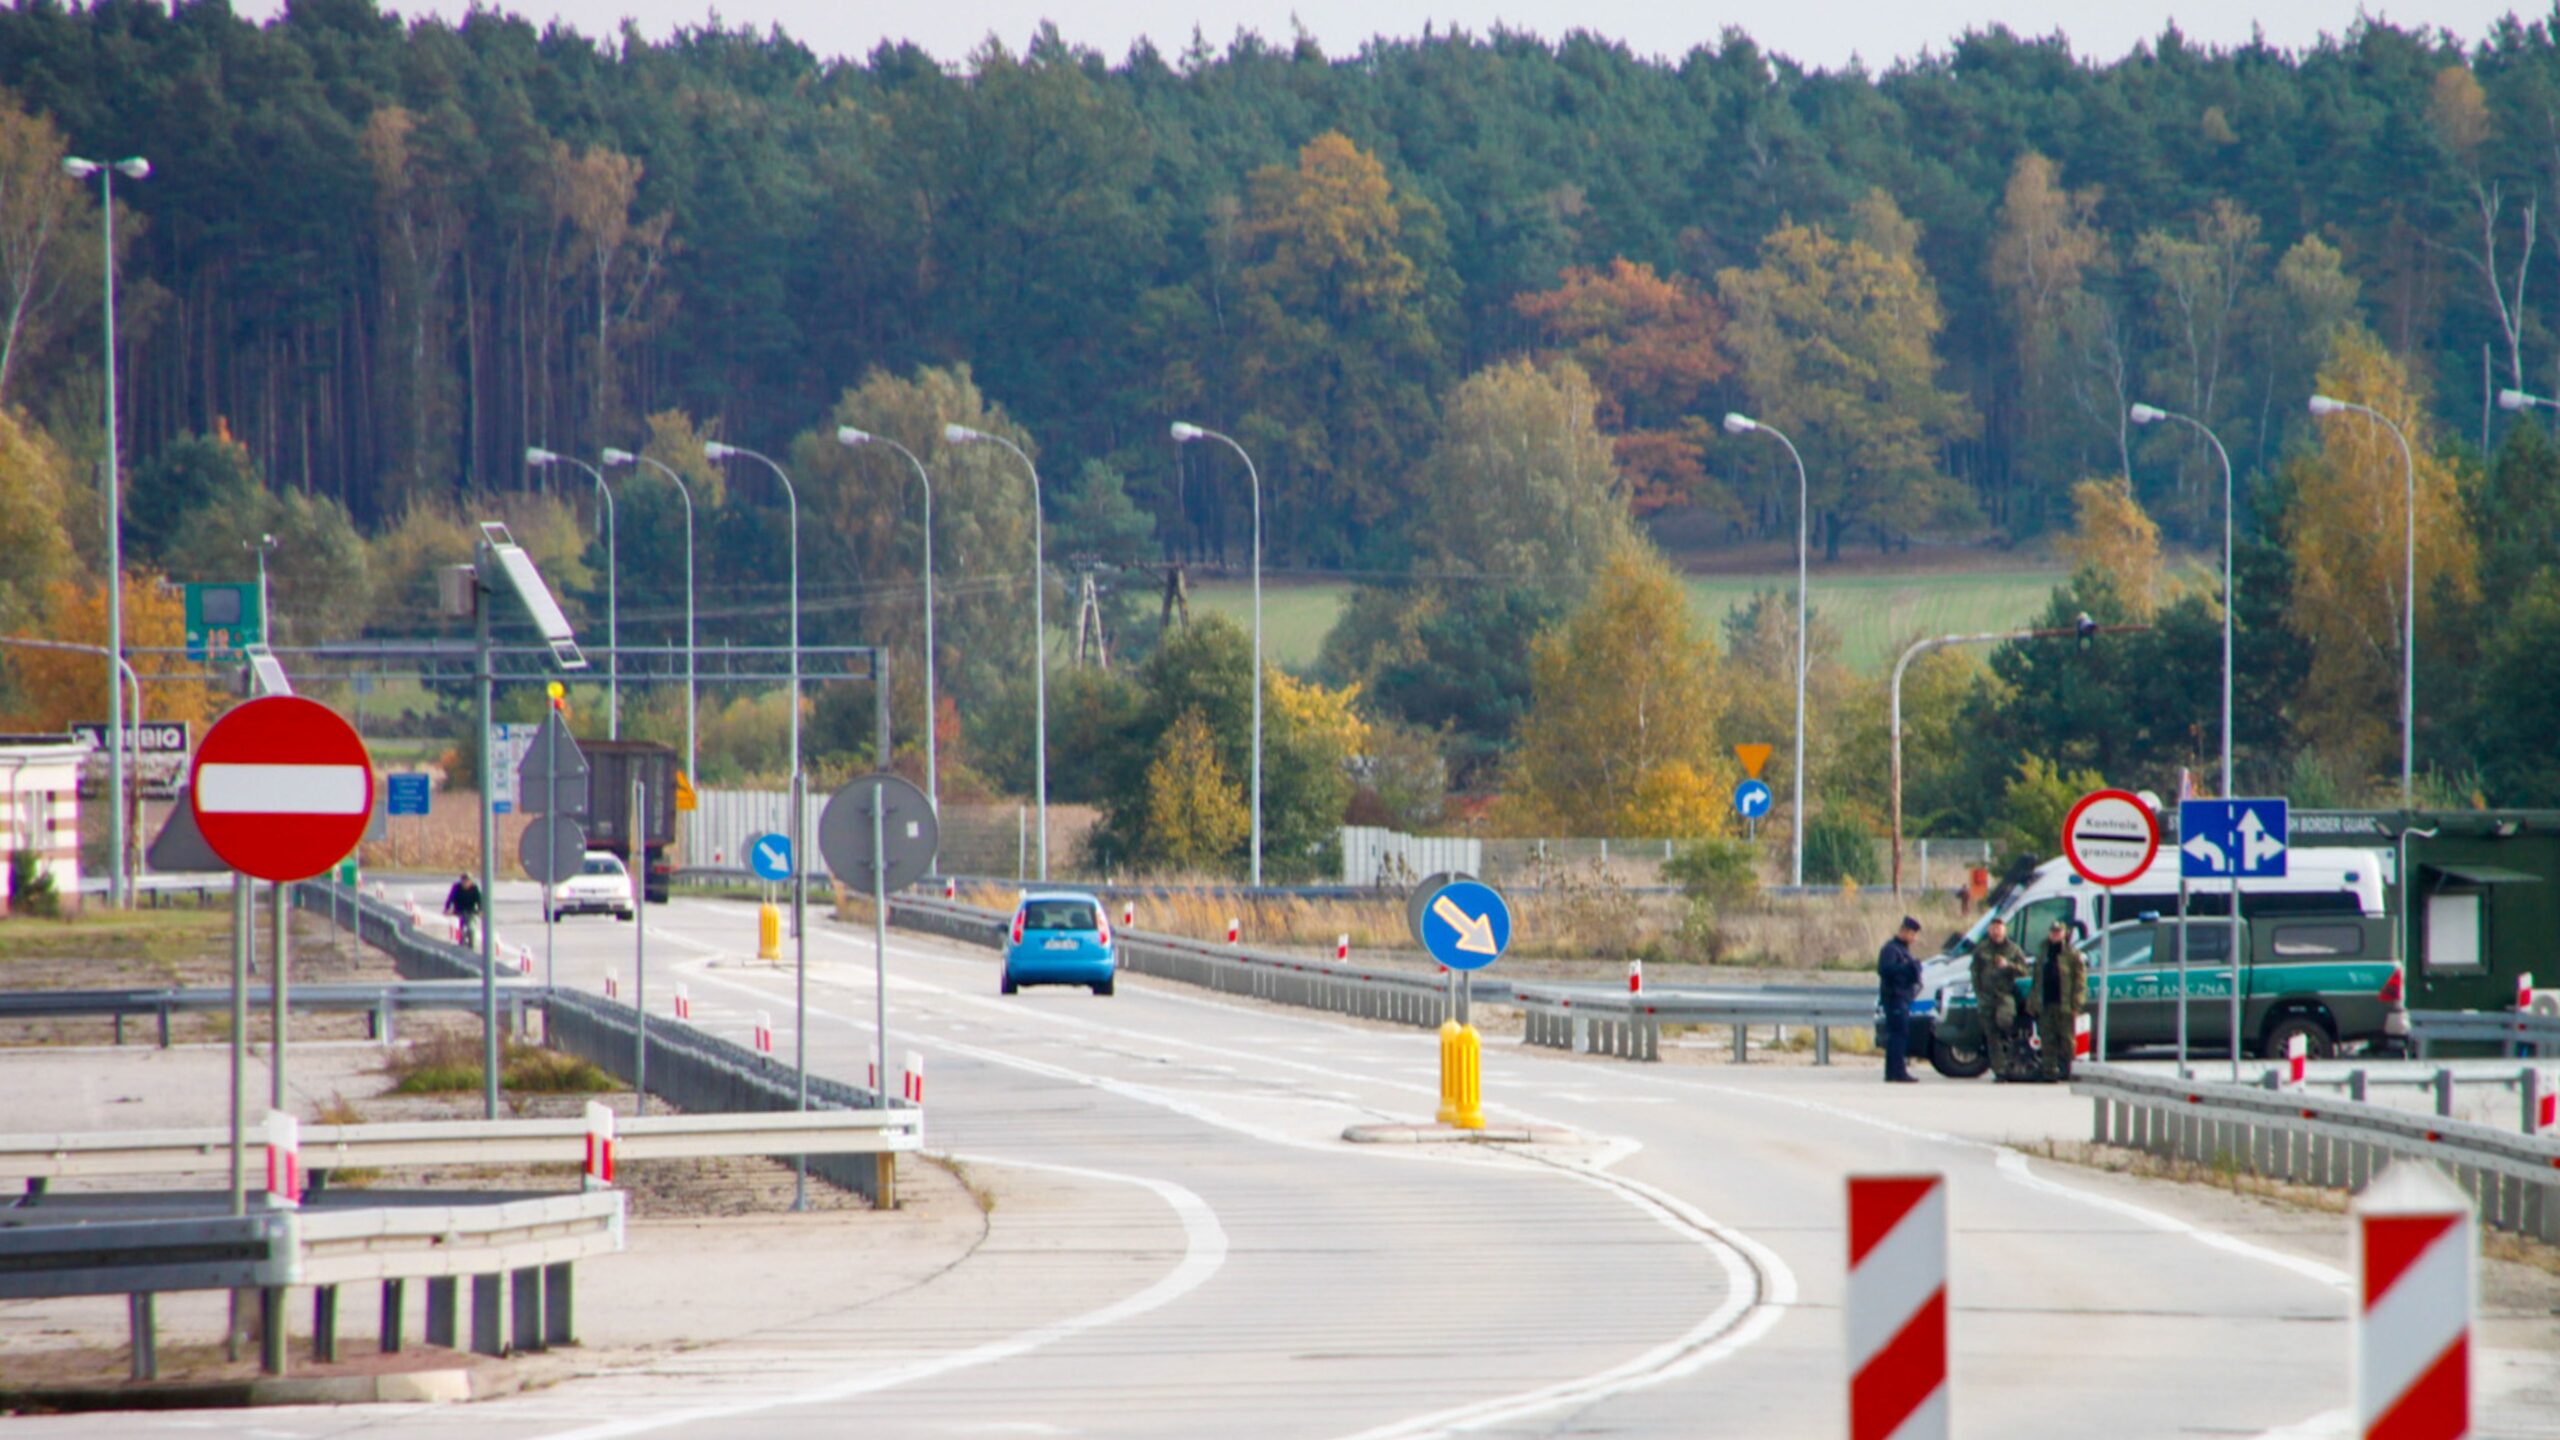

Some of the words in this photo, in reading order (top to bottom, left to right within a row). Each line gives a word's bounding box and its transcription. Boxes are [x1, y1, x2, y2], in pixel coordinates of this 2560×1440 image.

[2086, 818, 2138, 831] Kontrola
[2301, 816, 2340, 833] BORDER
[2137, 983, 2227, 998] GRANCZNA
